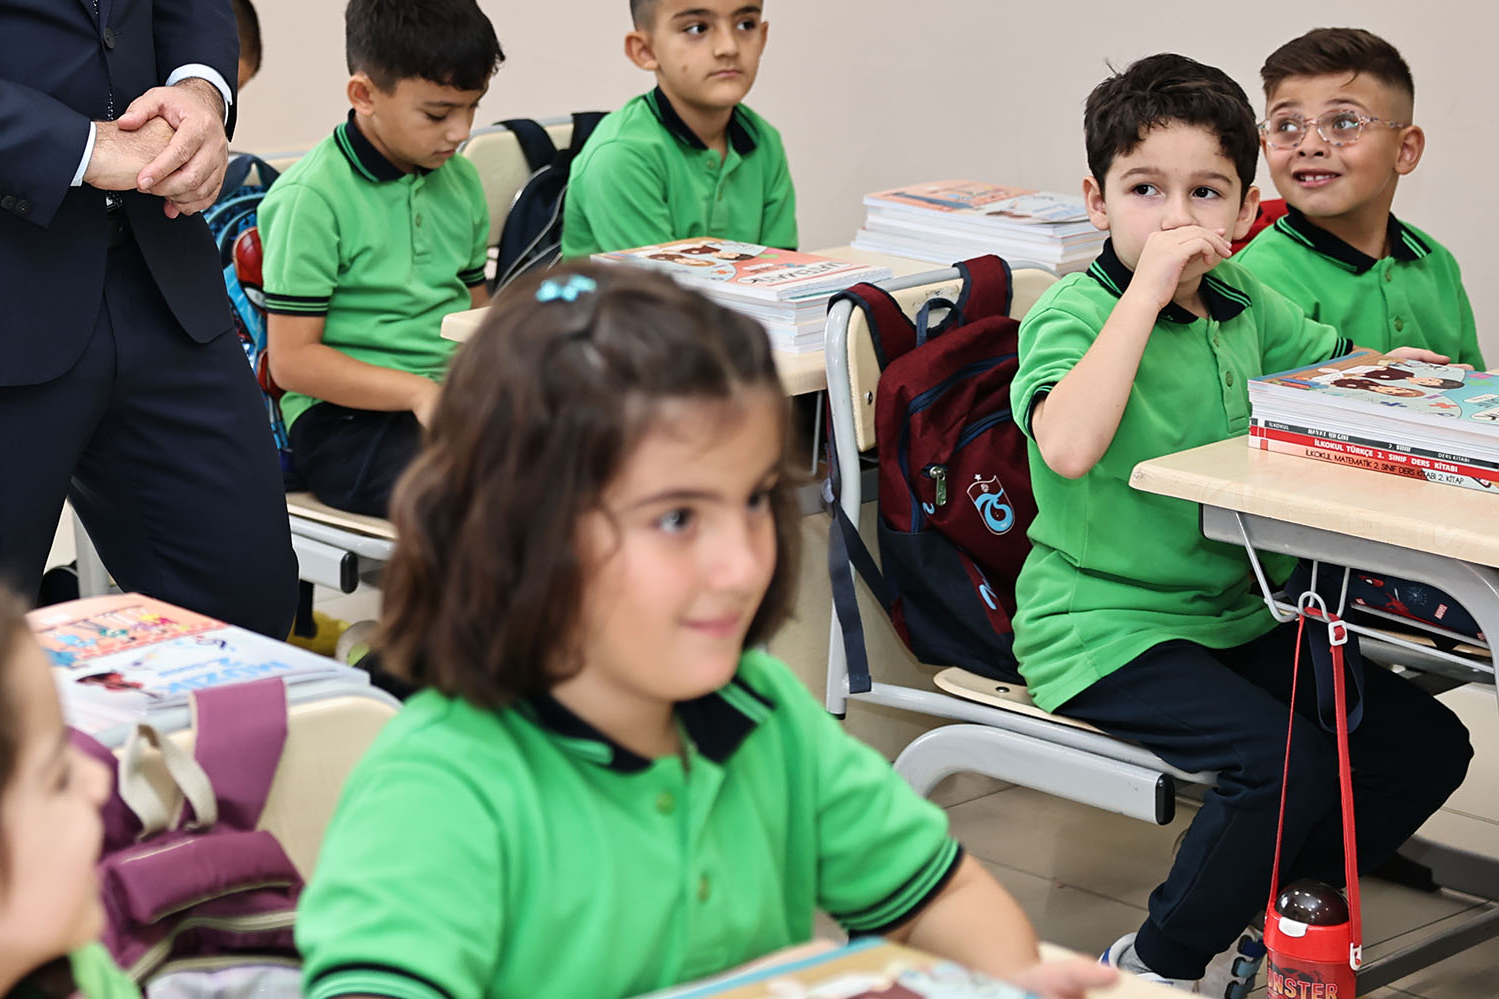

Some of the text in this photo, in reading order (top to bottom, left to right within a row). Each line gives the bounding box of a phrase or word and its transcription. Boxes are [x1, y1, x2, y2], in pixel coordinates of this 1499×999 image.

[1305, 449, 1332, 460] İLKOKUL
[1334, 455, 1372, 468] MATEMATİK
[1399, 466, 1415, 476] DERS
[1446, 475, 1464, 485] KİTAP
[1314, 438, 1458, 473] İLKOKUL TÜRKÇE 2. SINIF DERS KİTABI
[1437, 452, 1452, 460] DERS
